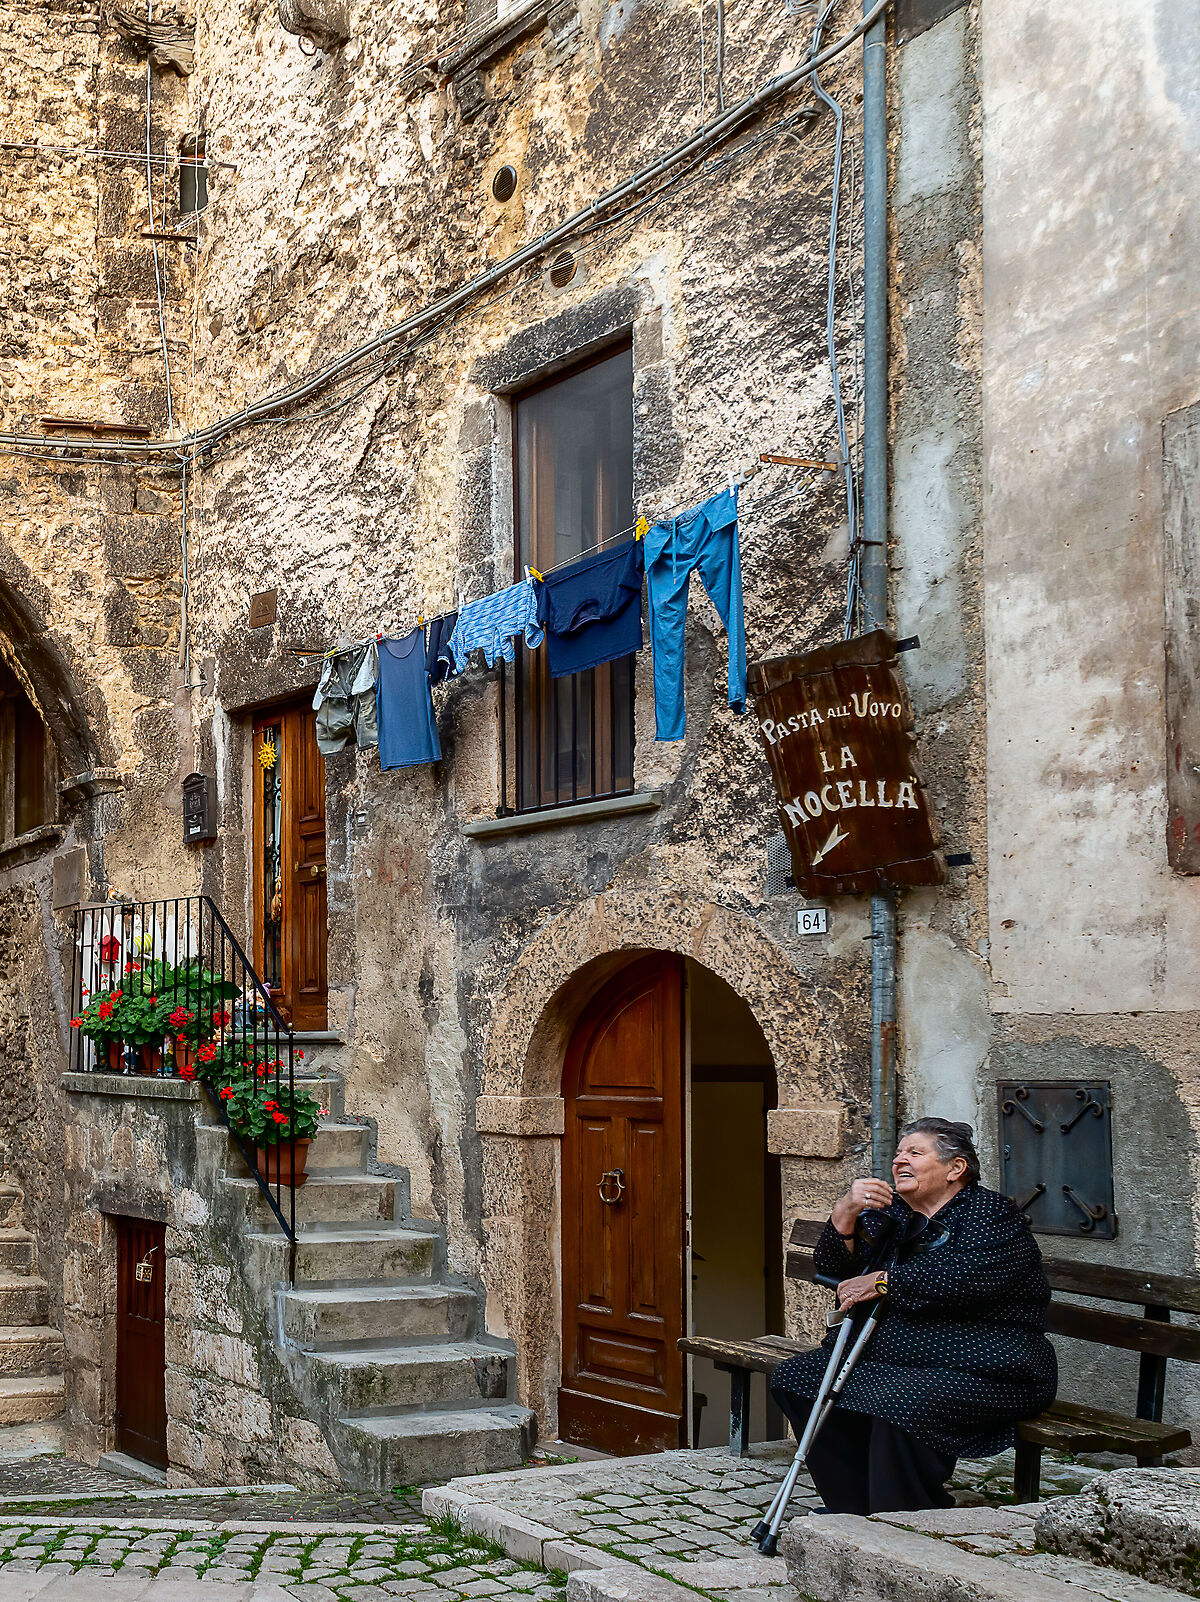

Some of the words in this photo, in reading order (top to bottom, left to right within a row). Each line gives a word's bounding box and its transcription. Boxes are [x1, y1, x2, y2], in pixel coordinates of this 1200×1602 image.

[760, 708, 824, 745] PASTA
[820, 746, 857, 772] LA
[803, 913, 820, 930] 64
